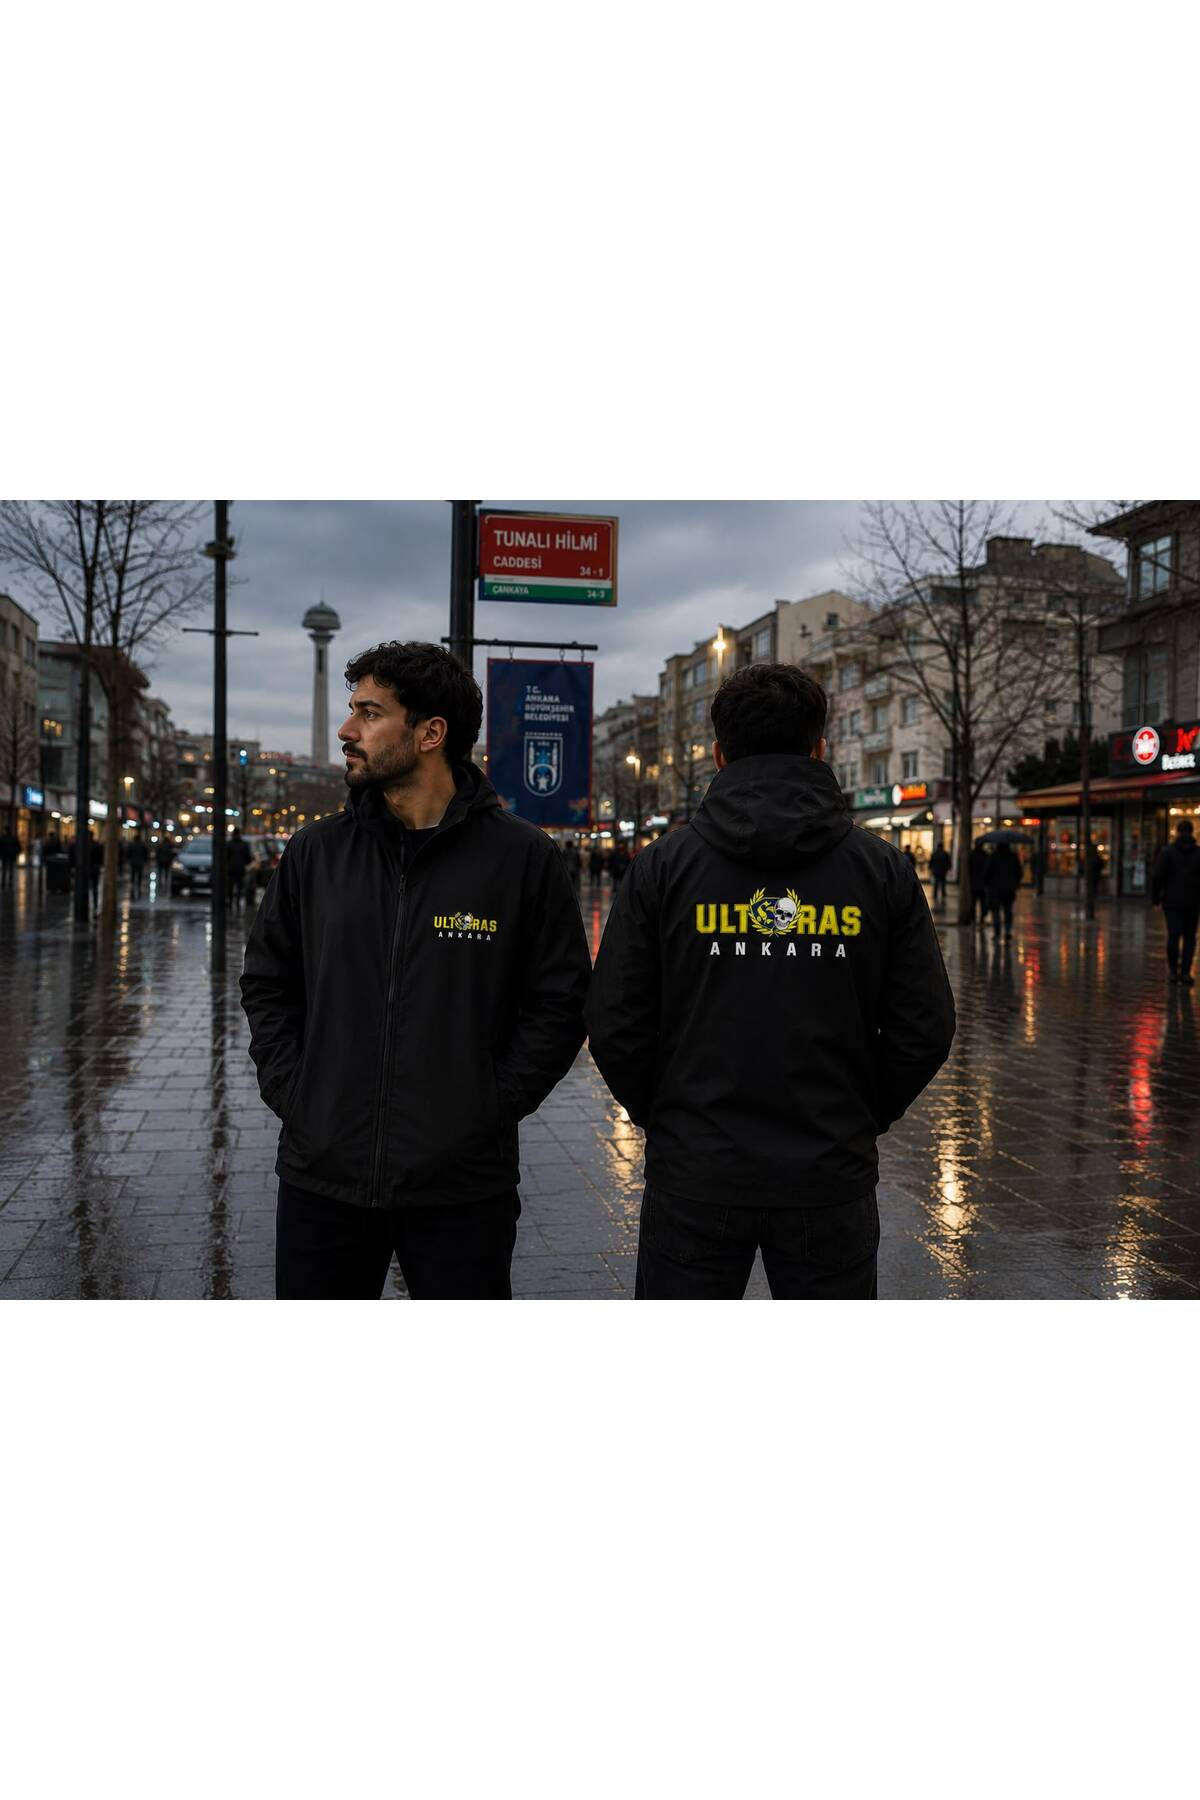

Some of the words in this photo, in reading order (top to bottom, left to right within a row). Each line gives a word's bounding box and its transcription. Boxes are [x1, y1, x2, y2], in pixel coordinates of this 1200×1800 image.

[494, 530, 550, 549] TUNALI
[555, 530, 598, 552] HİLMİ
[493, 555, 542, 569] CADDESİ
[525, 694, 560, 703] ANKARA
[438, 931, 491, 941] ANKARA
[710, 942, 846, 957] ANKARA
